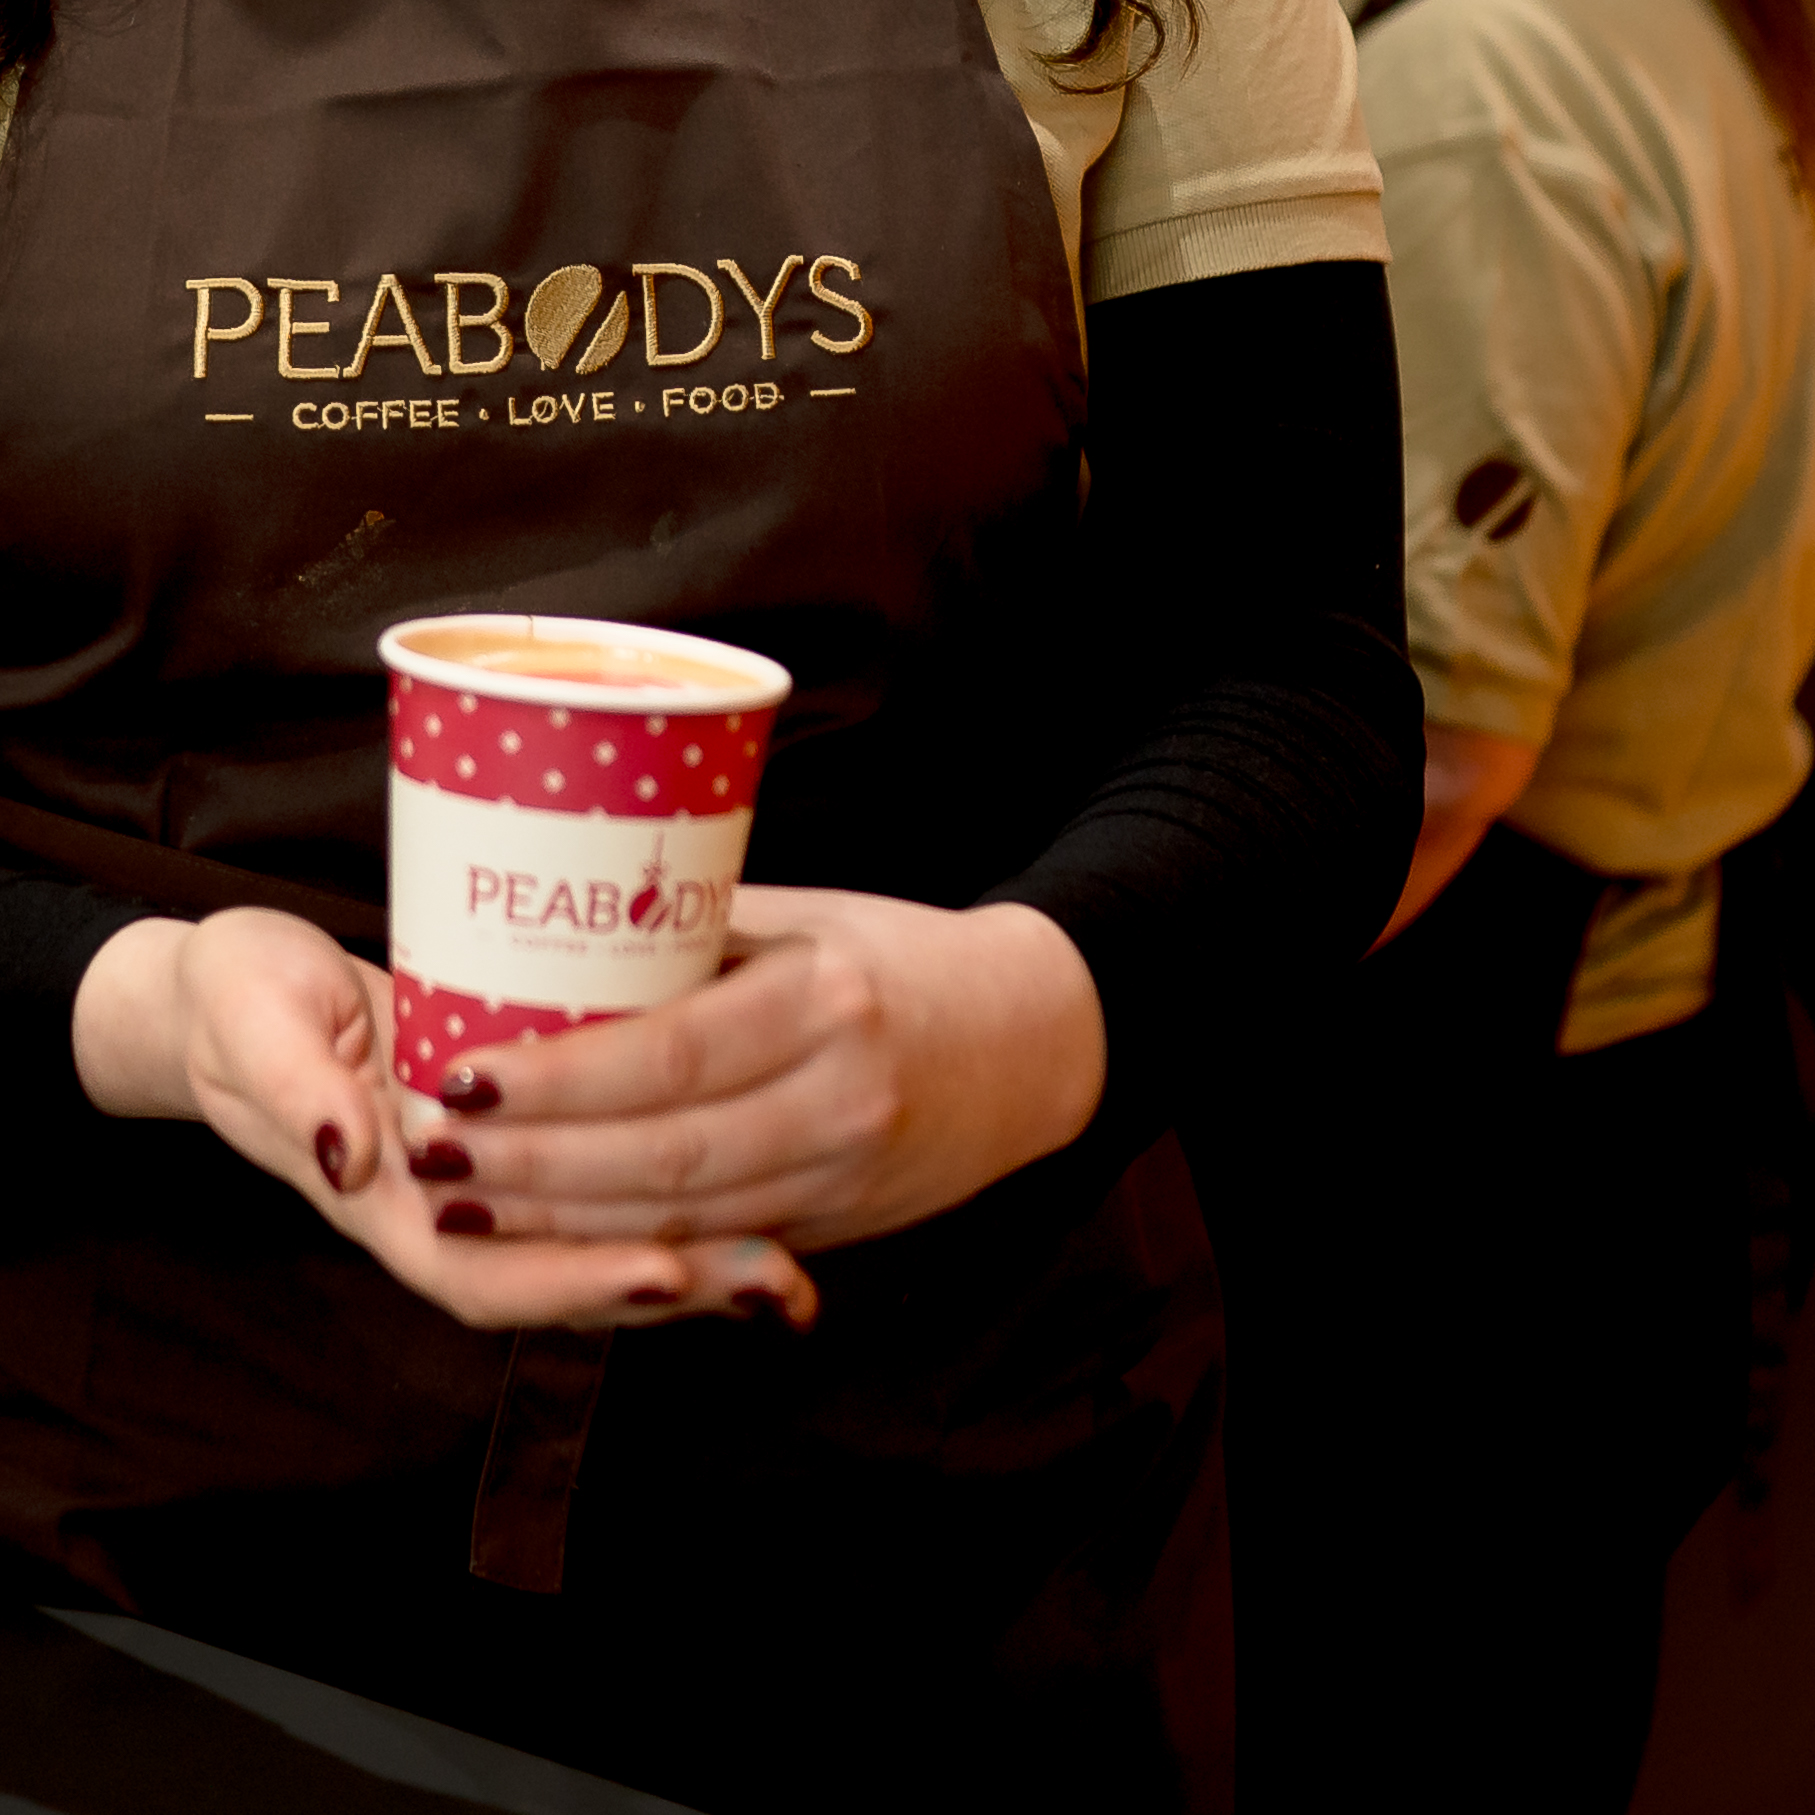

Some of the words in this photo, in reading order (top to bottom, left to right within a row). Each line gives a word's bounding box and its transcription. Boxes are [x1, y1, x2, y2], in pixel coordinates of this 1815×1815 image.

[185, 254, 875, 380] PEABODYS
[291, 398, 461, 431] COFFEE
[507, 390, 617, 427] LOVE
[662, 382, 785, 417] FOOD
